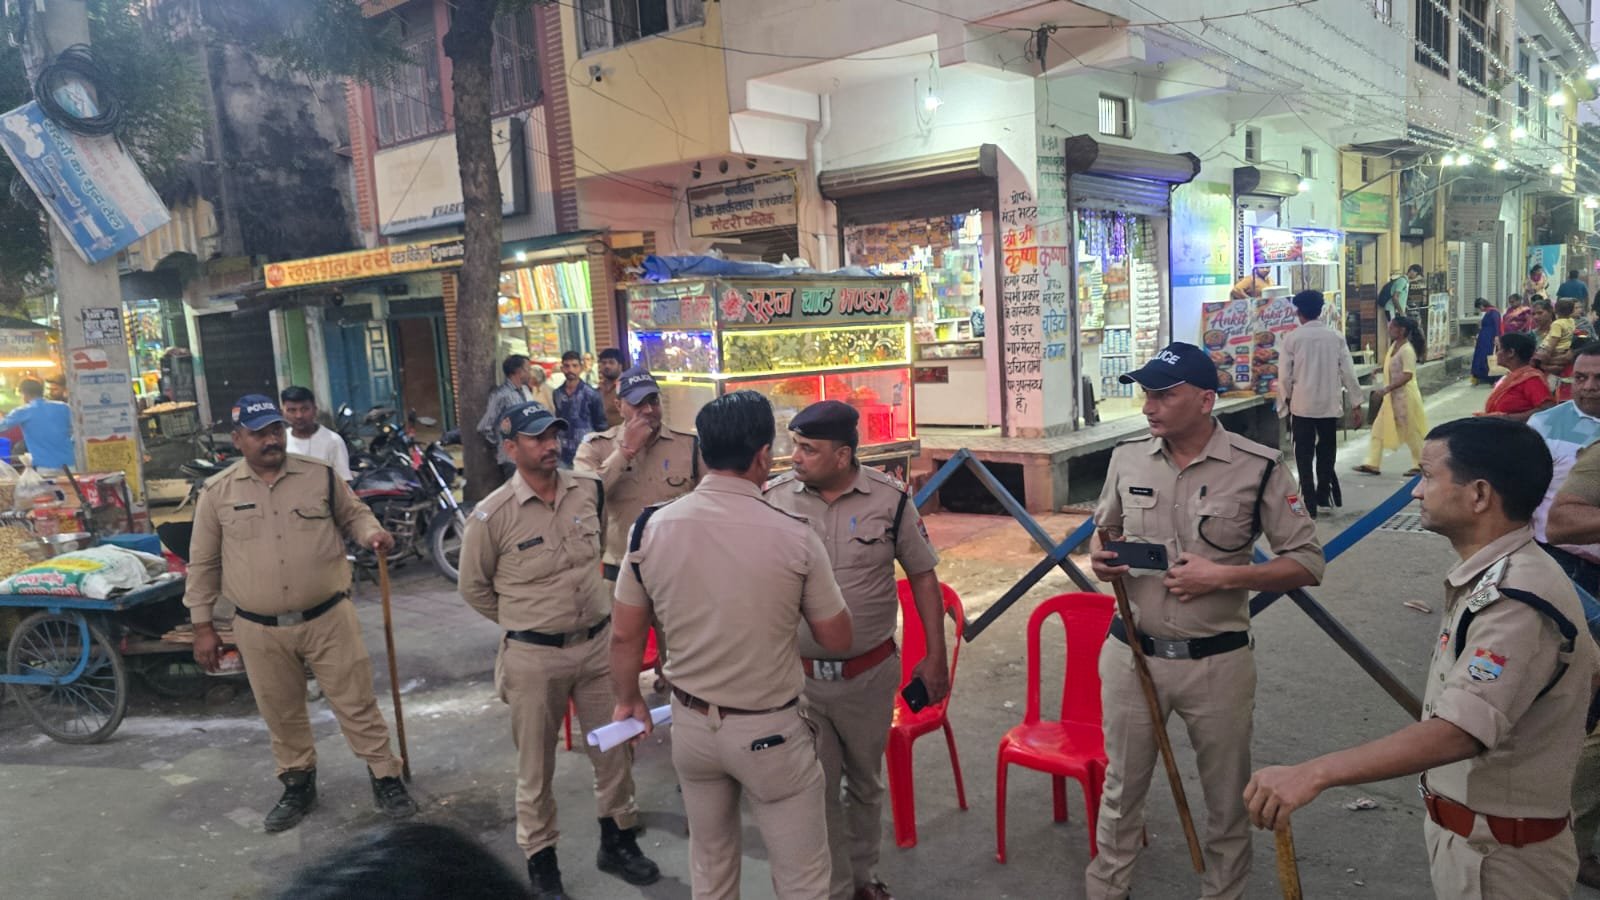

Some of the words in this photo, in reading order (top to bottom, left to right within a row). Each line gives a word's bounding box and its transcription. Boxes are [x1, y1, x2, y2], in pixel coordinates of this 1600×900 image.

[746, 287, 796, 323] सूरज
[800, 287, 834, 317] चाट
[1210, 310, 1248, 328] Ankit
